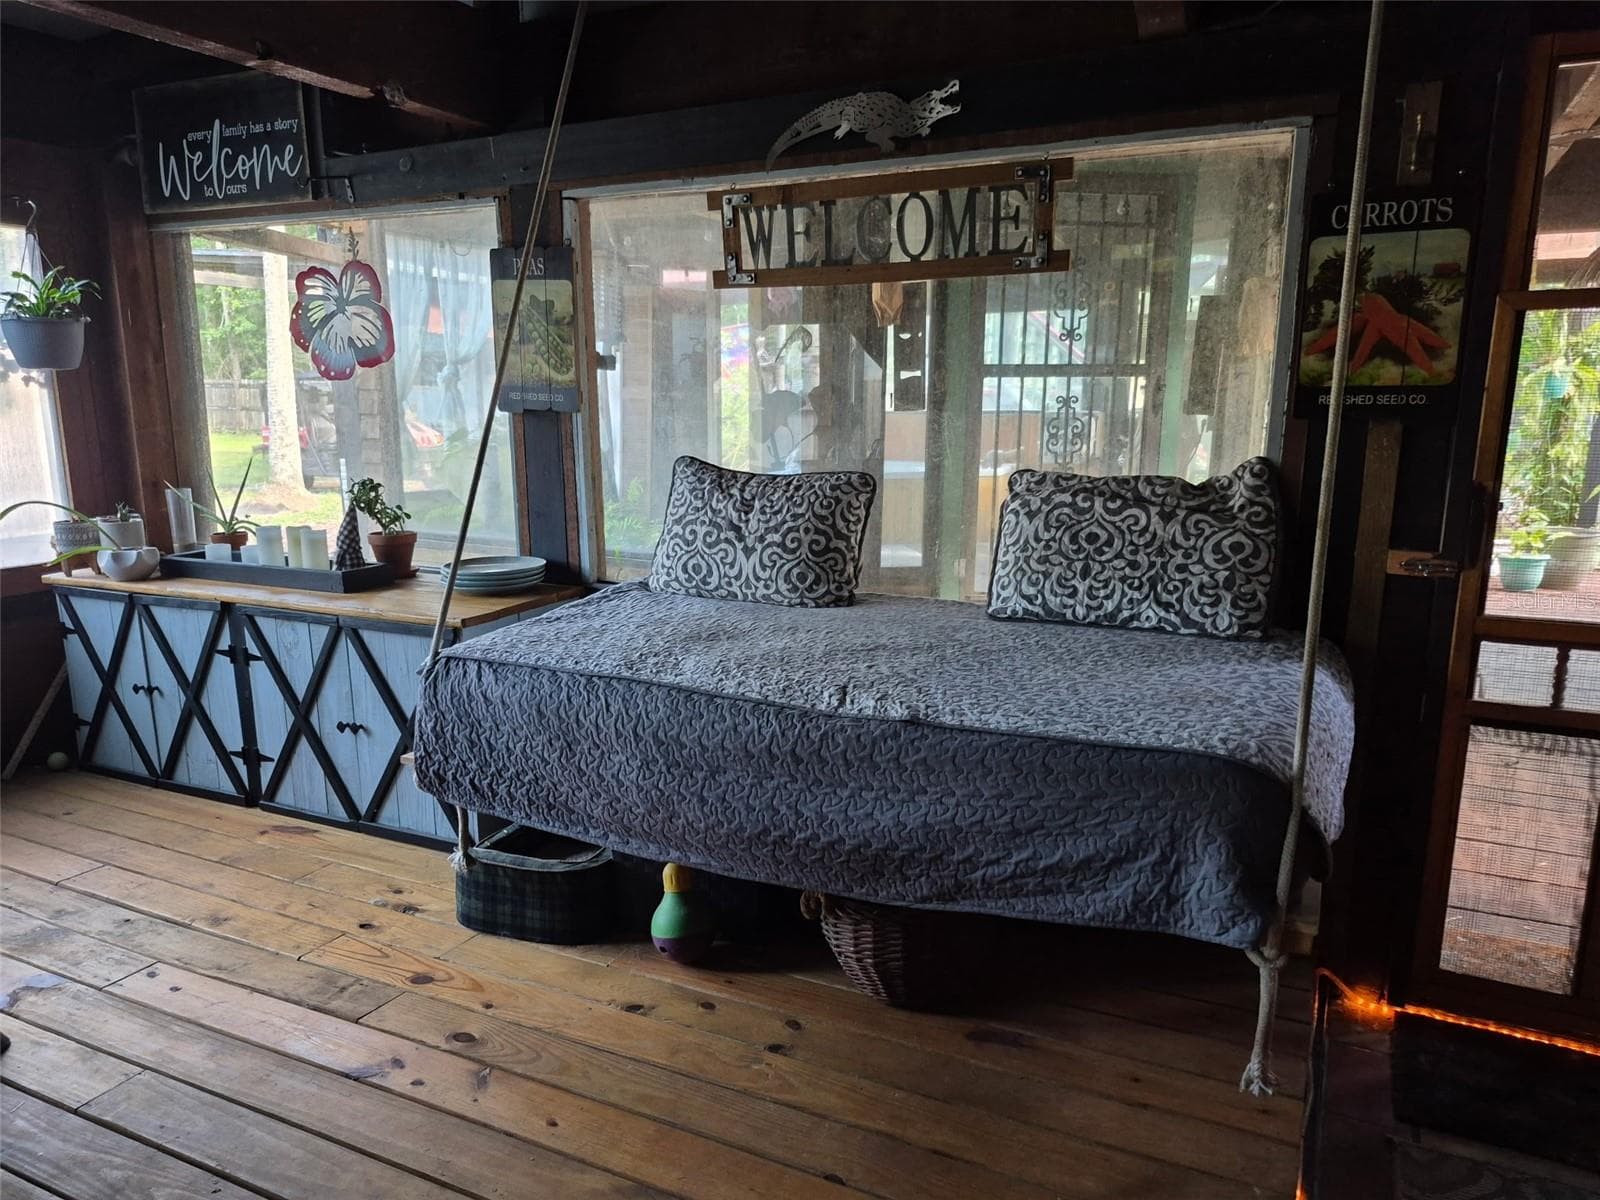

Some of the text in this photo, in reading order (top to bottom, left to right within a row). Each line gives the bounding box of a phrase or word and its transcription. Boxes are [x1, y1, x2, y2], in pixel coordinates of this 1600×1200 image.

[187, 117, 299, 144] every family has a story
[159, 118, 303, 200] Welcome
[204, 183, 248, 197] to ours
[739, 183, 1029, 270] WELCOME
[1331, 197, 1453, 229] CRROTS
[513, 257, 545, 276] PAS
[1345, 394, 1374, 405] SHED
[1375, 394, 1406, 405] SEED
